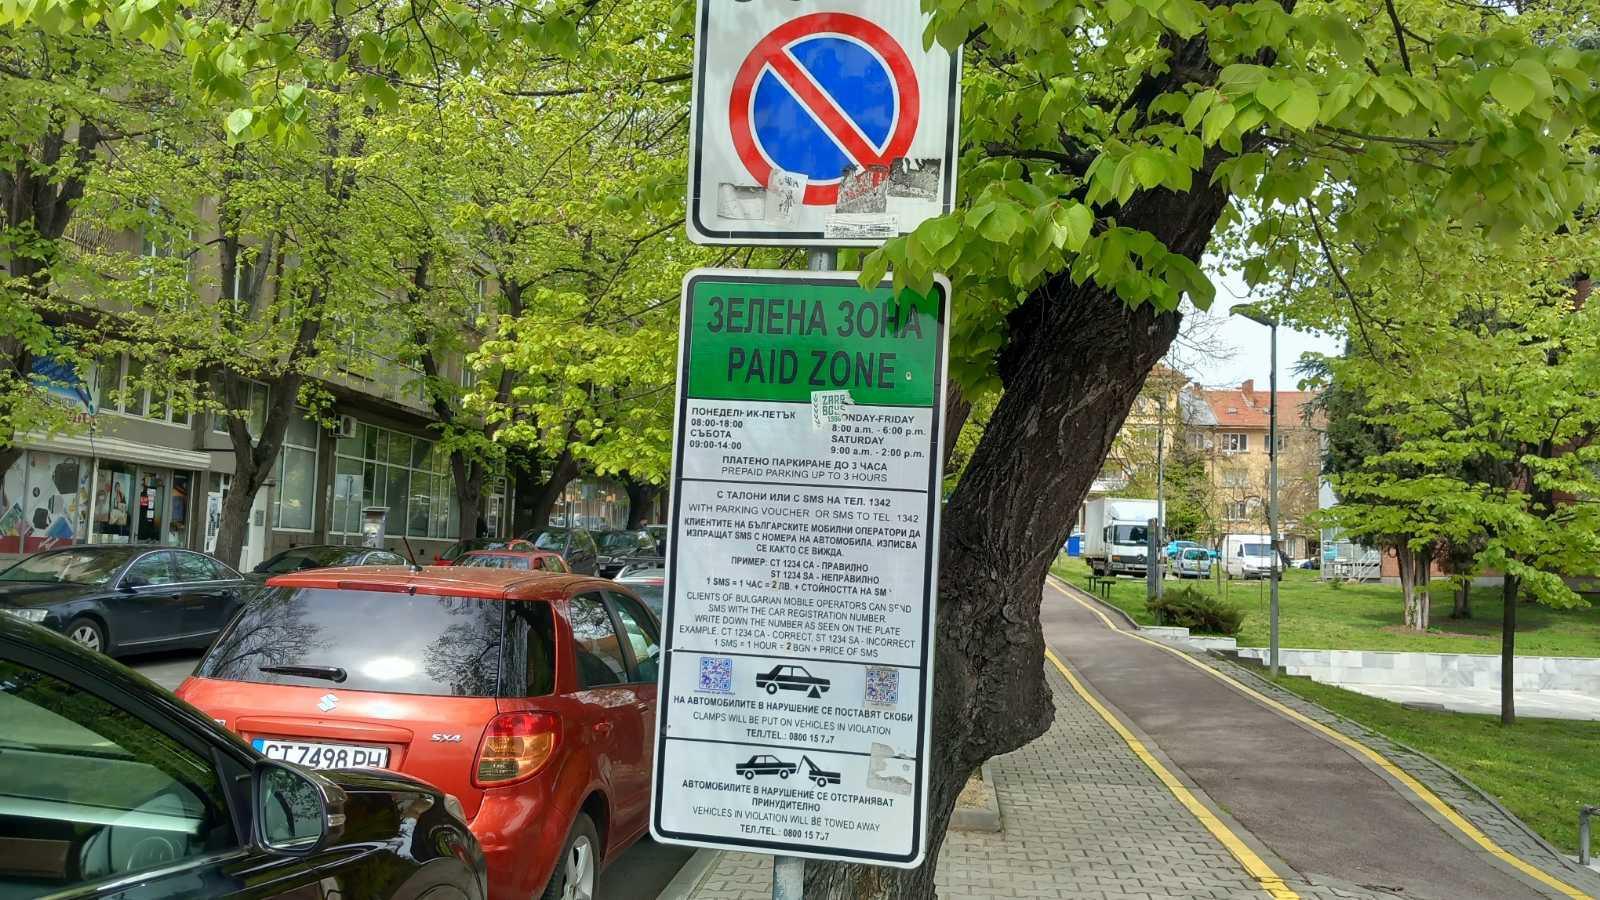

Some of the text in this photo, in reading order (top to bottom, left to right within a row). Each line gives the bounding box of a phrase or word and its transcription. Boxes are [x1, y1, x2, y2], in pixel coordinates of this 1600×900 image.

[707, 296, 922, 340] ЗЕЛЕНА ЗОНА
[727, 346, 897, 389] PAID ZONE
[690, 417, 743, 428] 08:00-18:00
[841, 413, 914, 424] ONDAY-FRIDAY
[690, 428, 731, 438] СЪБОТА
[831, 423, 851, 432] 8:00
[882, 425, 902, 435] 6:00
[689, 439, 741, 449] 09:00-14:00
[831, 434, 884, 445] SATURDAY
[830, 445, 850, 454] 9:00
[881, 447, 901, 456] 2:00
[722, 455, 887, 471] ПЛАТЕНО ПАРКИРАНЕ ДО 3 ЧАСА
[721, 466, 887, 482] PREPAID PARKING UP TO 3 HOURS
[716, 490, 723, 498] С
[726, 490, 766, 500] ТАЛОНИ
[769, 492, 790, 502] ИЛИ
[793, 494, 800, 502] С
[802, 494, 824, 504] SMS
[826, 495, 841, 504] НА
[869, 497, 890, 507] 1342
[688, 503, 918, 523] WITH PARKING VOUCHER OR SMS TO 1342
[684, 517, 920, 539] КЛИЕНТИТЕ НА БЪЛГАРСКИТЕ МОБИЛНИ ОПЕРАТОРИ ДА
[734, 530, 752, 540] SMS
[753, 531, 759, 540] С
[761, 532, 796, 542] НОМЕРА
[798, 534, 811, 543] НА
[876, 538, 917, 549] ИЗПИСВА
[756, 543, 767, 552] СЕ
[768, 544, 796, 554] КАКТО
[797, 545, 809, 555] СЕ
[769, 558, 780, 567] СТ
[782, 559, 800, 568] 1234
[802, 560, 814, 570] СА
[821, 561, 868, 573] ПРАВИЛНО
[770, 569, 879, 584] ST 1234 SA НЕПРАВИЛНО
[712, 577, 730, 586] SMS
[745, 579, 762, 588] ЧАС
[771, 580, 777, 588] 2
[800, 582, 857, 594] СТОЙНОСТТА
[859, 586, 872, 595] НА
[686, 591, 720, 601] CLIENTS
[722, 592, 733, 602] OF
[735, 593, 781, 604] BULGARIAN
[783, 596, 814, 606] MOBILE
[816, 599, 866, 610] OPERATORS
[868, 602, 886, 612] CAN
[708, 603, 726, 612] SMS
[727, 605, 748, 613] WITH
[750, 606, 766, 615] THE
[768, 607, 785, 616] CAR
[787, 608, 847, 620] REGISTRATION
[695, 614, 720, 624] WRITE
[722, 615, 748, 626] DOWN
[750, 617, 765, 627] THE
[767, 619, 803, 629] NUMBER
[804, 620, 815, 630] AS
[817, 621, 839, 631] SEEN
[841, 623, 854, 632] ON
[856, 624, 872, 634] THE
[720, 626, 732, 635] CT
[734, 628, 752, 637] 1234
[753, 629, 765, 638] CA
[815, 633, 826, 642] ST
[828, 634, 846, 644] 1234
[848, 635, 859, 645] SA
[866, 636, 915, 648] INCORRECT
[720, 638, 878, 657] SMS HOUR 2 BGN PRICE OF SMS
[673, 695, 913, 722] НА АВТОМОБИЛИТЕ В НАРУШЕНИЕ СЕ ПОСТАВЯТ СКОБИ
[692, 711, 890, 735] CLAMPS WILL BE PUT ON VEHICLES IN VIOLATION
[431, 733, 463, 742] SX4
[788, 732, 818, 743] 0800 15
[298, 746, 348, 768] 7498
[352, 750, 382, 767] PH
[682, 778, 893, 807] АВТОМОБИЛИТЕ В НАРУШЕНИЕ СЕ ОТСТРАНЯВАТ
[751, 797, 820, 812] ПРИНУДИТЕЛНО
[692, 805, 879, 831] VEHICLES IN VIOLATION WILL BE TOWED AWAY
[783, 828, 813, 839] 0800 15
